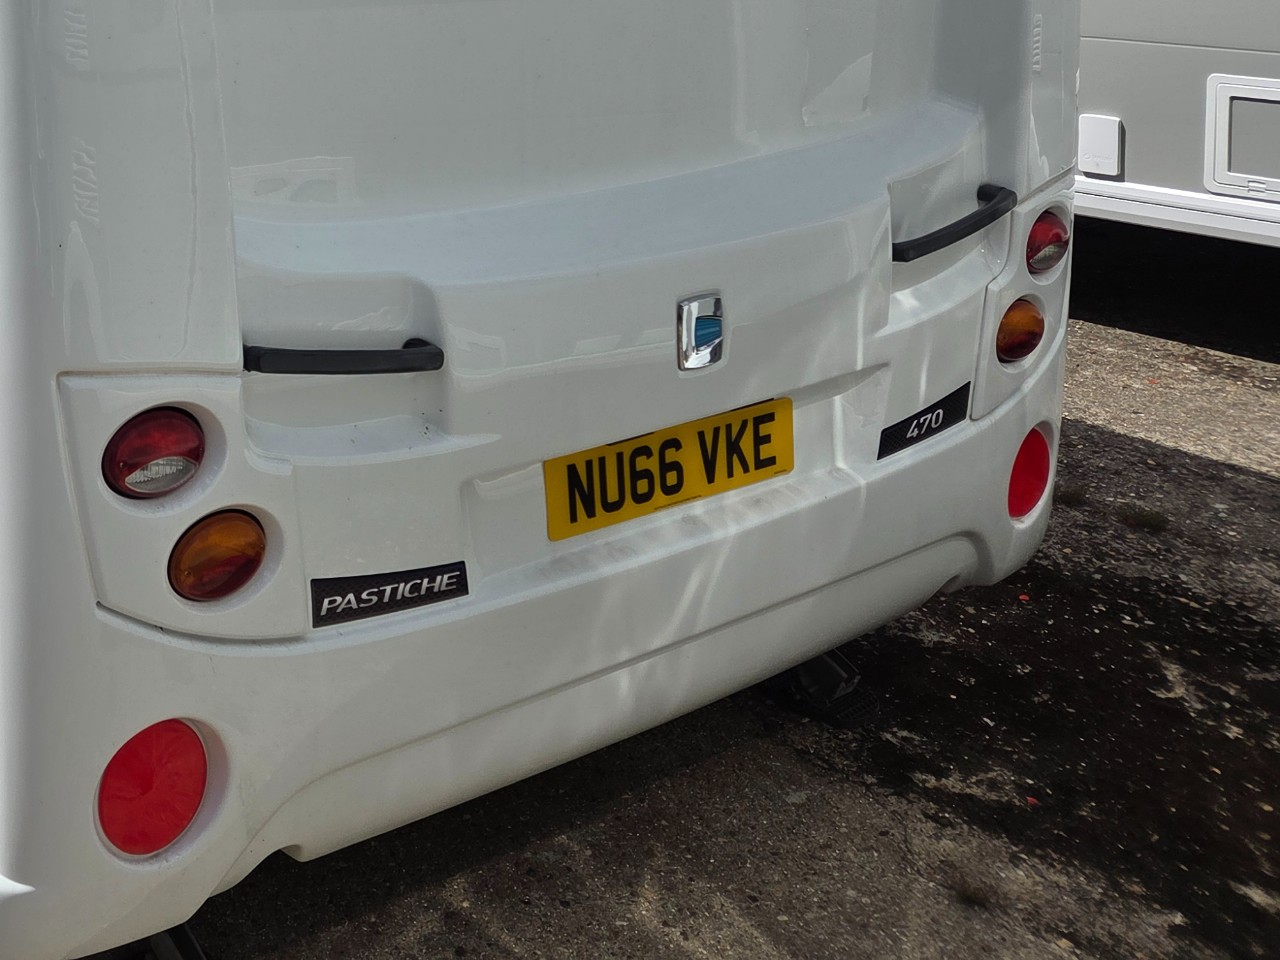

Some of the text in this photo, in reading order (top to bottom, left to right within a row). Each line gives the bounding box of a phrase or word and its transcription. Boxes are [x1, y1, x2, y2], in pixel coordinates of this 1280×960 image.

[906, 409, 943, 439] 470
[566, 411, 777, 525] NU66 VKE
[320, 571, 461, 616] PASTICHE
